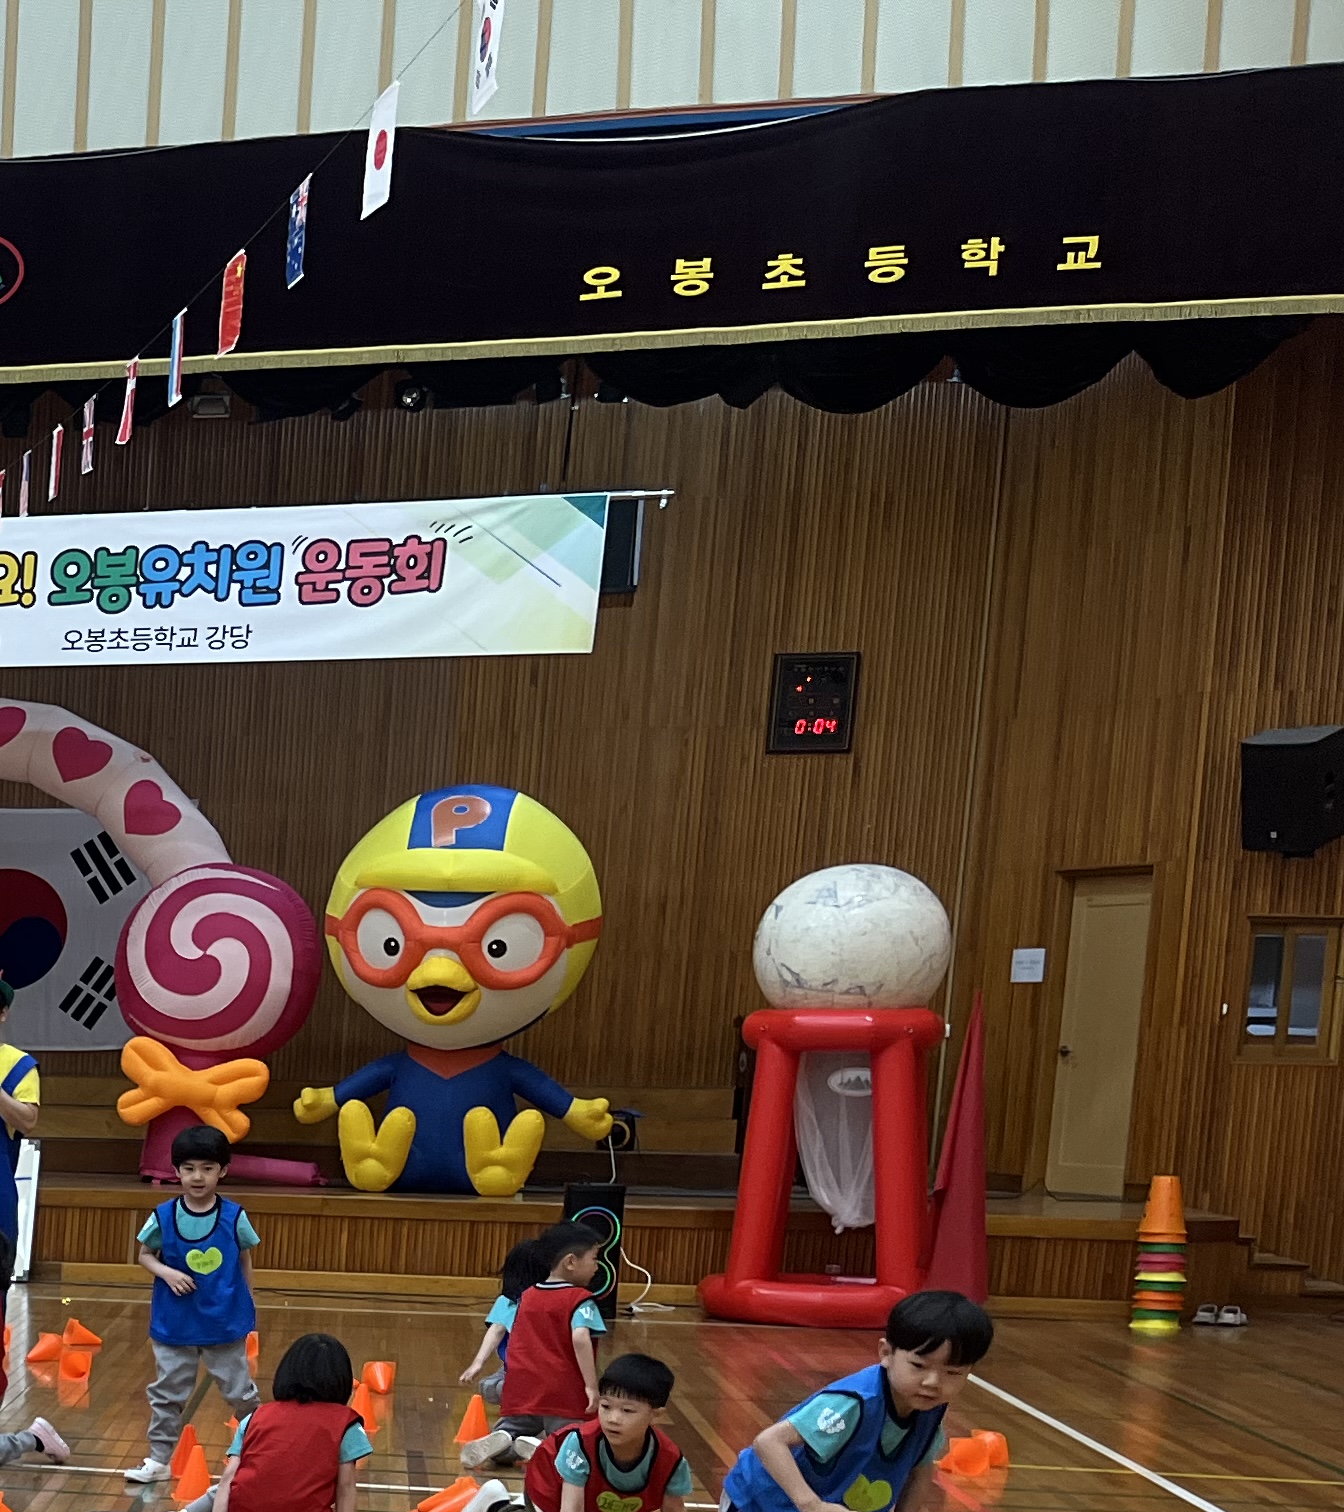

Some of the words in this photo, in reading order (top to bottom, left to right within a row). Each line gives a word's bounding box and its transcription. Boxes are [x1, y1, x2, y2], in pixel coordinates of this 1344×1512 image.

[47, 539, 285, 614] 오봉유치원
[295, 534, 449, 608] 운동회
[61, 626, 200, 653] 오봉초등학교
[205, 624, 254, 651] 강당
[430, 794, 492, 849] P
